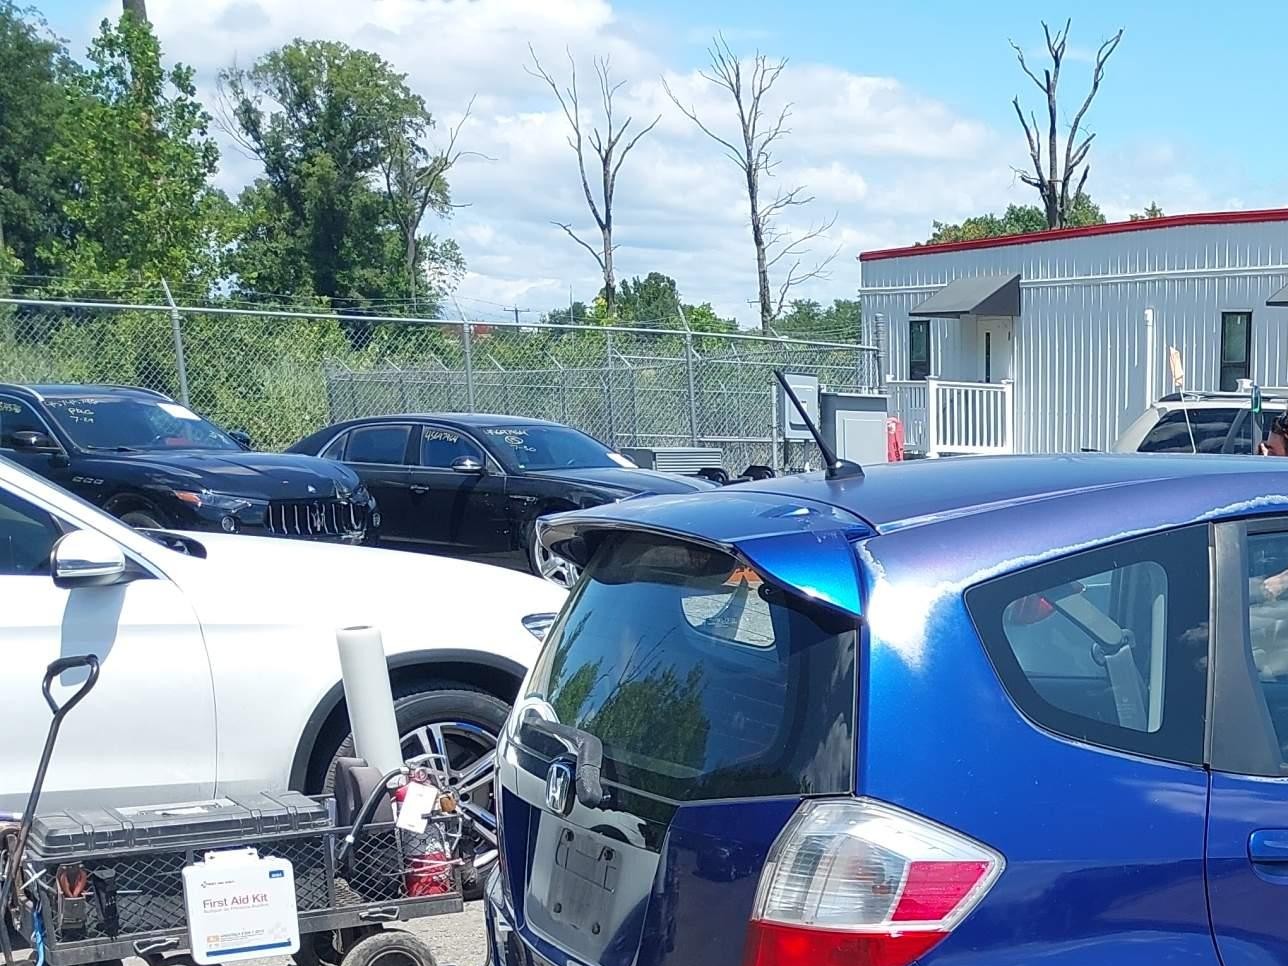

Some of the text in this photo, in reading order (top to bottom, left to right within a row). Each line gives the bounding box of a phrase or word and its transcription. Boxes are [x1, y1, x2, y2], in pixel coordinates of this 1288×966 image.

[203, 898, 228, 909] First
[231, 895, 249, 905] Aid
[252, 893, 268, 904] Kit
